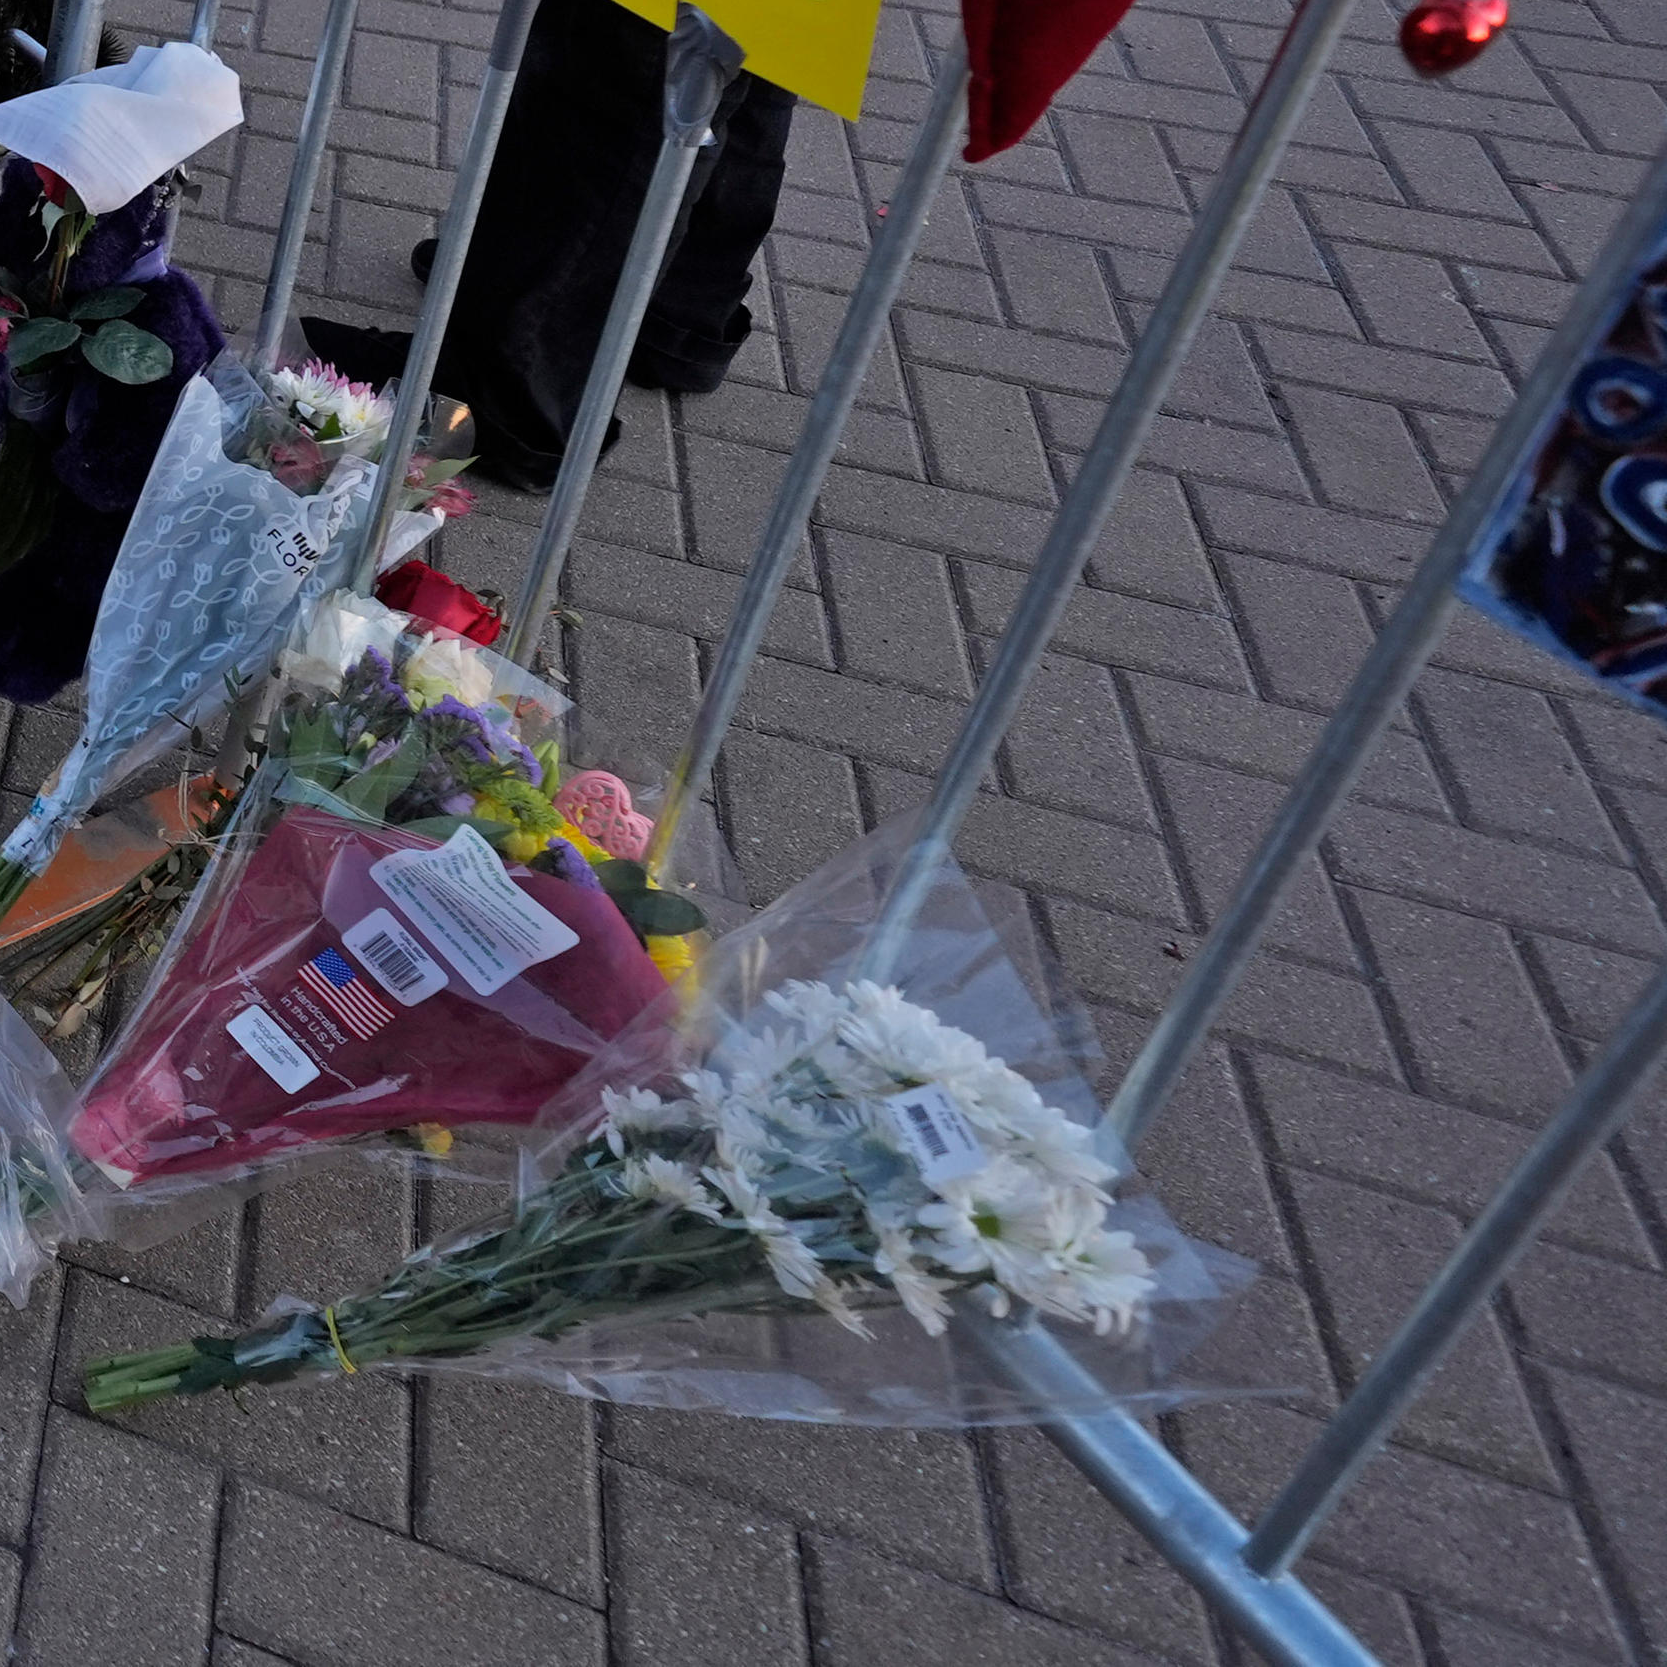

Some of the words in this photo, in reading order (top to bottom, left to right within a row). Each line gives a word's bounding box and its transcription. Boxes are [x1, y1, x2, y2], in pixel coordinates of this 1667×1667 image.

[279, 993, 294, 1007] in
[290, 1004, 310, 1024] the
[305, 1020, 337, 1053] U.S.A
[289, 984, 348, 1046] Handcrafted
